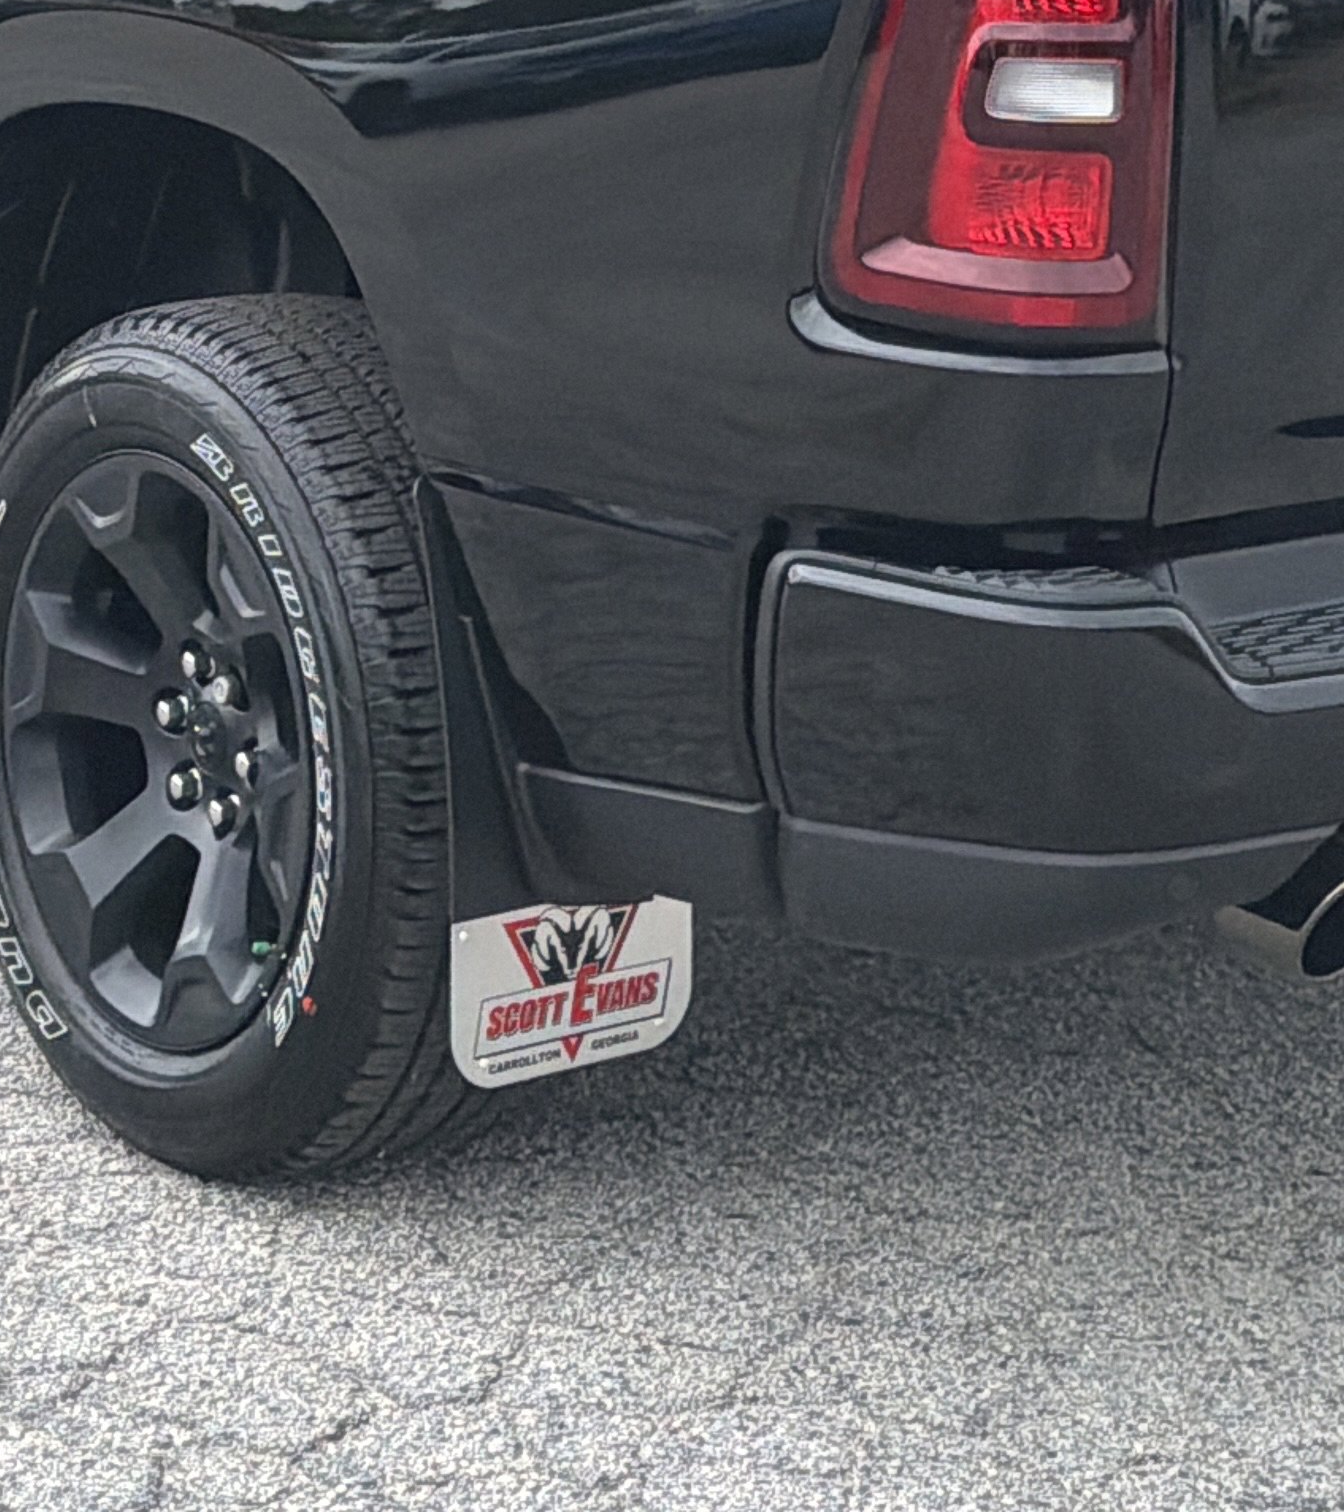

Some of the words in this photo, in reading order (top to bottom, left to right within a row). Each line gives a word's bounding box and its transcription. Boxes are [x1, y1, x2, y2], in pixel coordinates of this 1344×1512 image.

[191, 432, 331, 1048] BRIDGESTONE
[486, 992, 568, 1041] SCOTT
[570, 963, 660, 1027] EVANS
[488, 1048, 562, 1075] CARROLLTON
[591, 1030, 639, 1051] GEORGIA
